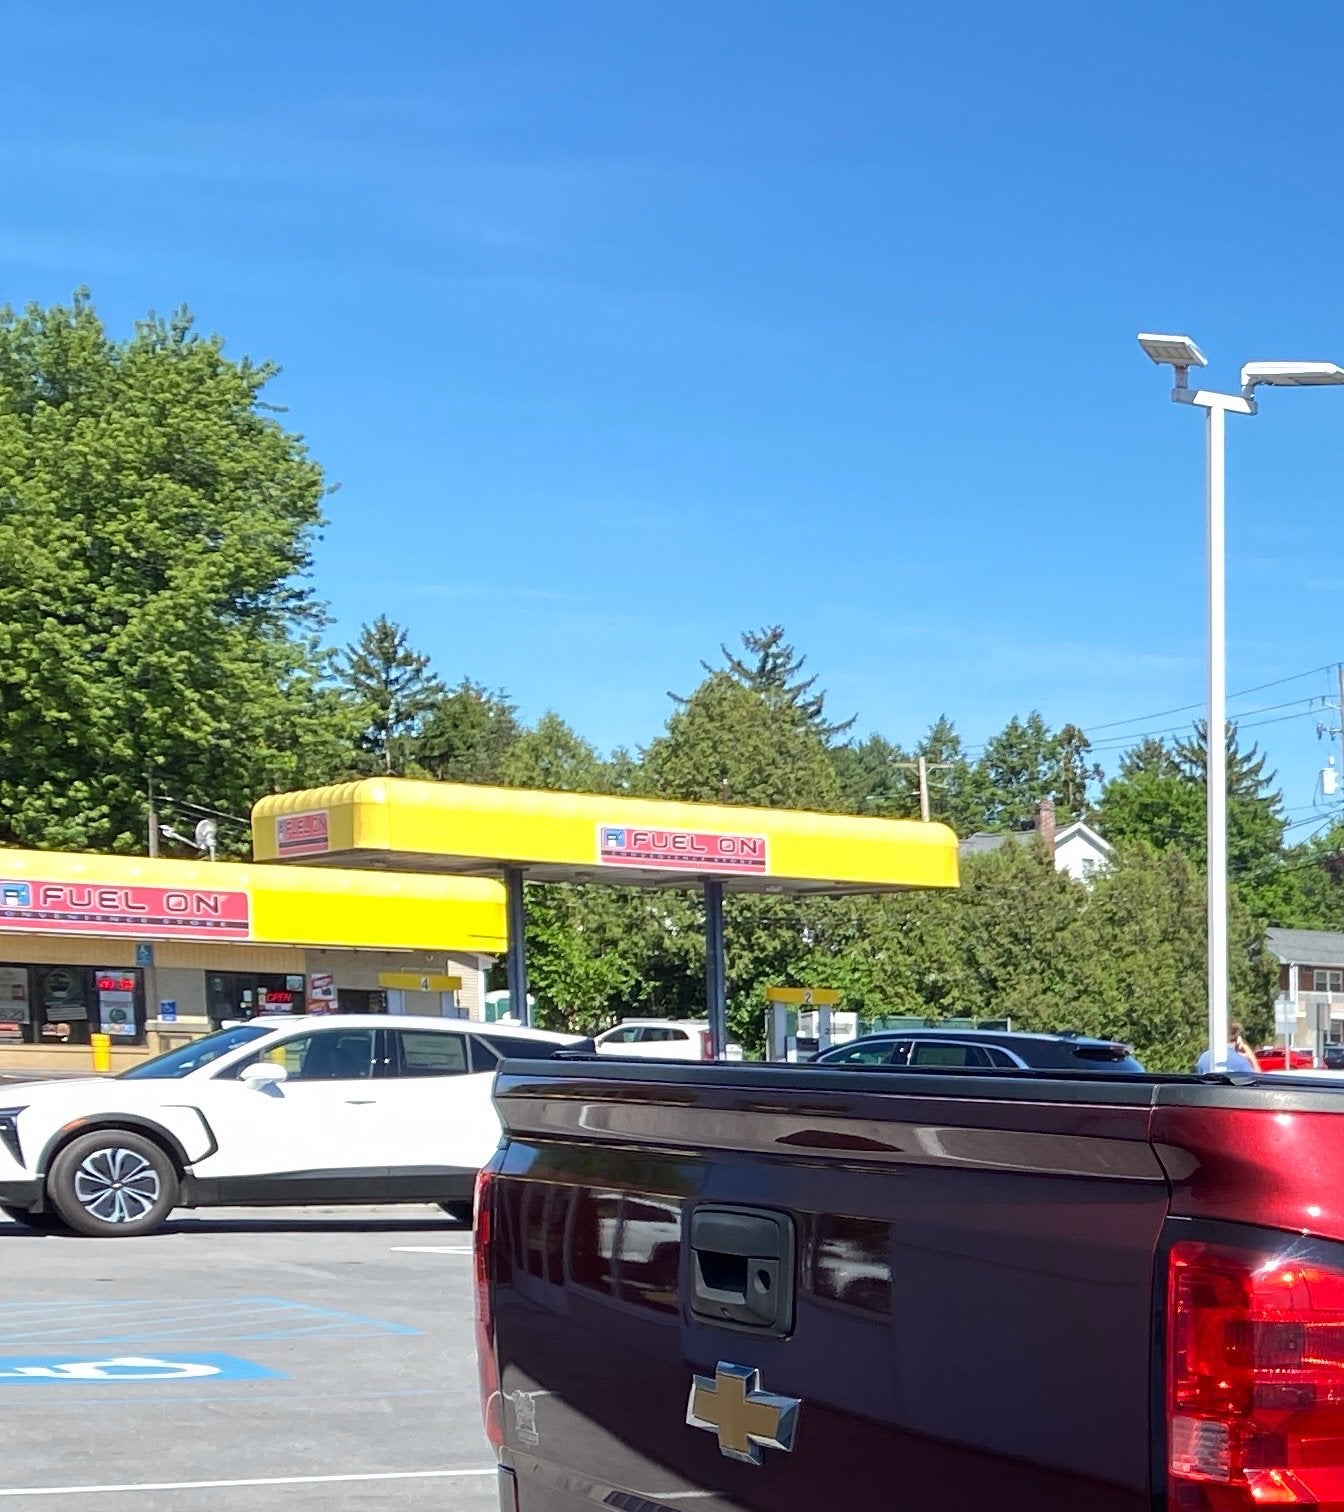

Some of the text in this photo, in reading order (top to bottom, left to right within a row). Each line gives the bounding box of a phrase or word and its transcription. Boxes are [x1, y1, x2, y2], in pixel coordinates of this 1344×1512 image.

[632, 831, 758, 854] FUEL ON
[41, 886, 221, 915] FUEL ON
[0, 909, 148, 924] ONVENIENCE
[421, 977, 429, 991] 4
